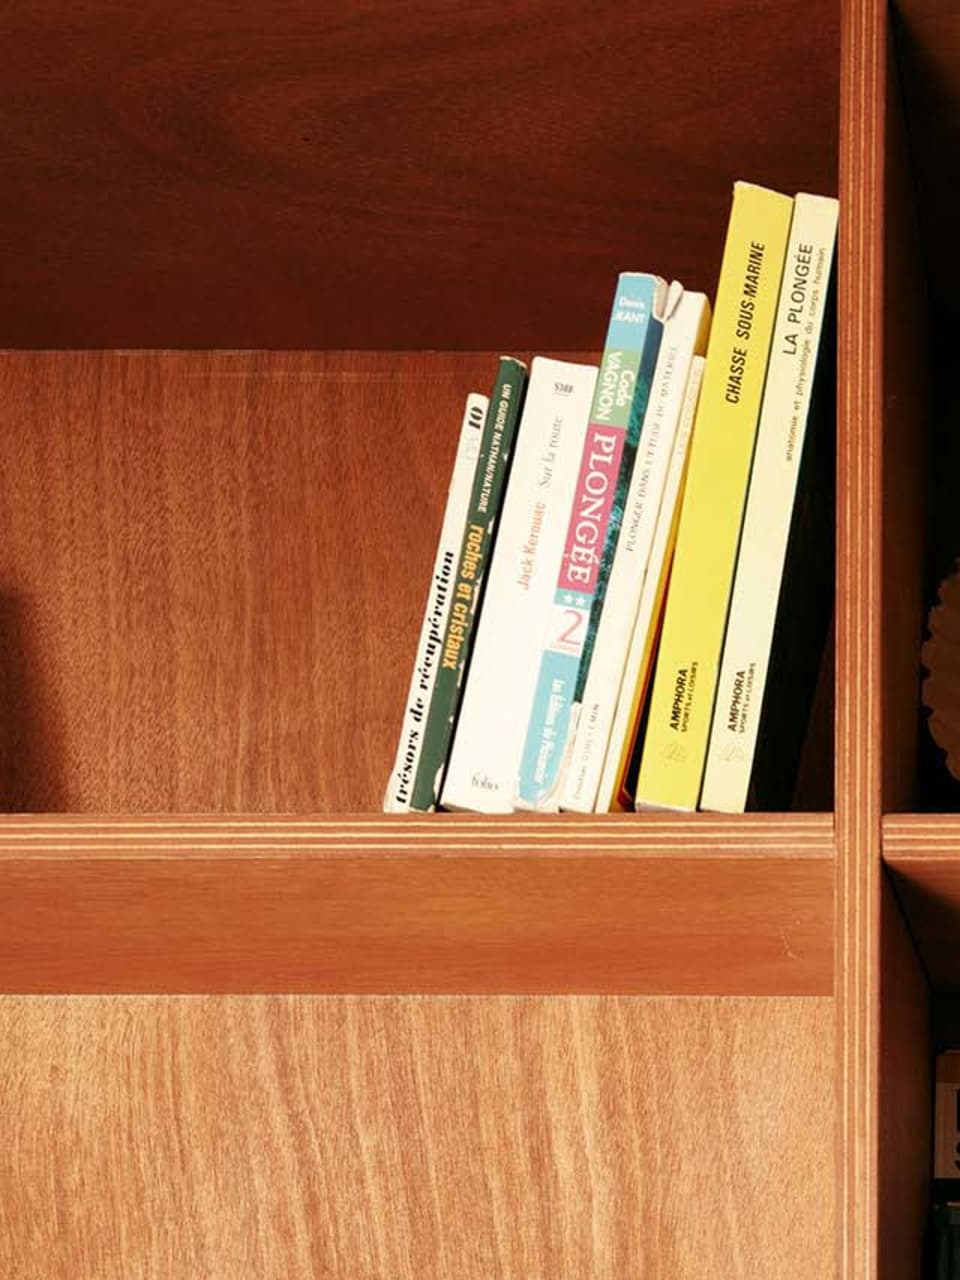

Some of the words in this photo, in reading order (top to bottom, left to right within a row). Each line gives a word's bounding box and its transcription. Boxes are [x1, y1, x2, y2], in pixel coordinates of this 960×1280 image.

[788, 243, 813, 324] PLONGÉE
[783, 333, 799, 356] LA
[793, 401, 801, 411] et
[804, 321, 814, 334] du
[501, 384, 512, 400] UN
[596, 351, 622, 421] VAGNON
[615, 370, 635, 406] Code
[725, 347, 747, 404] CHASSE
[494, 400, 509, 432] GUIDE
[539, 464, 553, 488] Sur
[523, 501, 547, 556] Kerouac
[566, 432, 617, 584] PLONGÉE
[461, 524, 485, 580] roches
[516, 557, 535, 591] Jack
[457, 583, 473, 601] et
[442, 603, 469, 670] cristaux
[557, 609, 583, 646] 2
[396, 729, 419, 803] trésors
[409, 698, 424, 722] de
[418, 551, 454, 691] récupération
[669, 668, 688, 731] AMPHORA
[727, 670, 746, 732] AMPHORA
